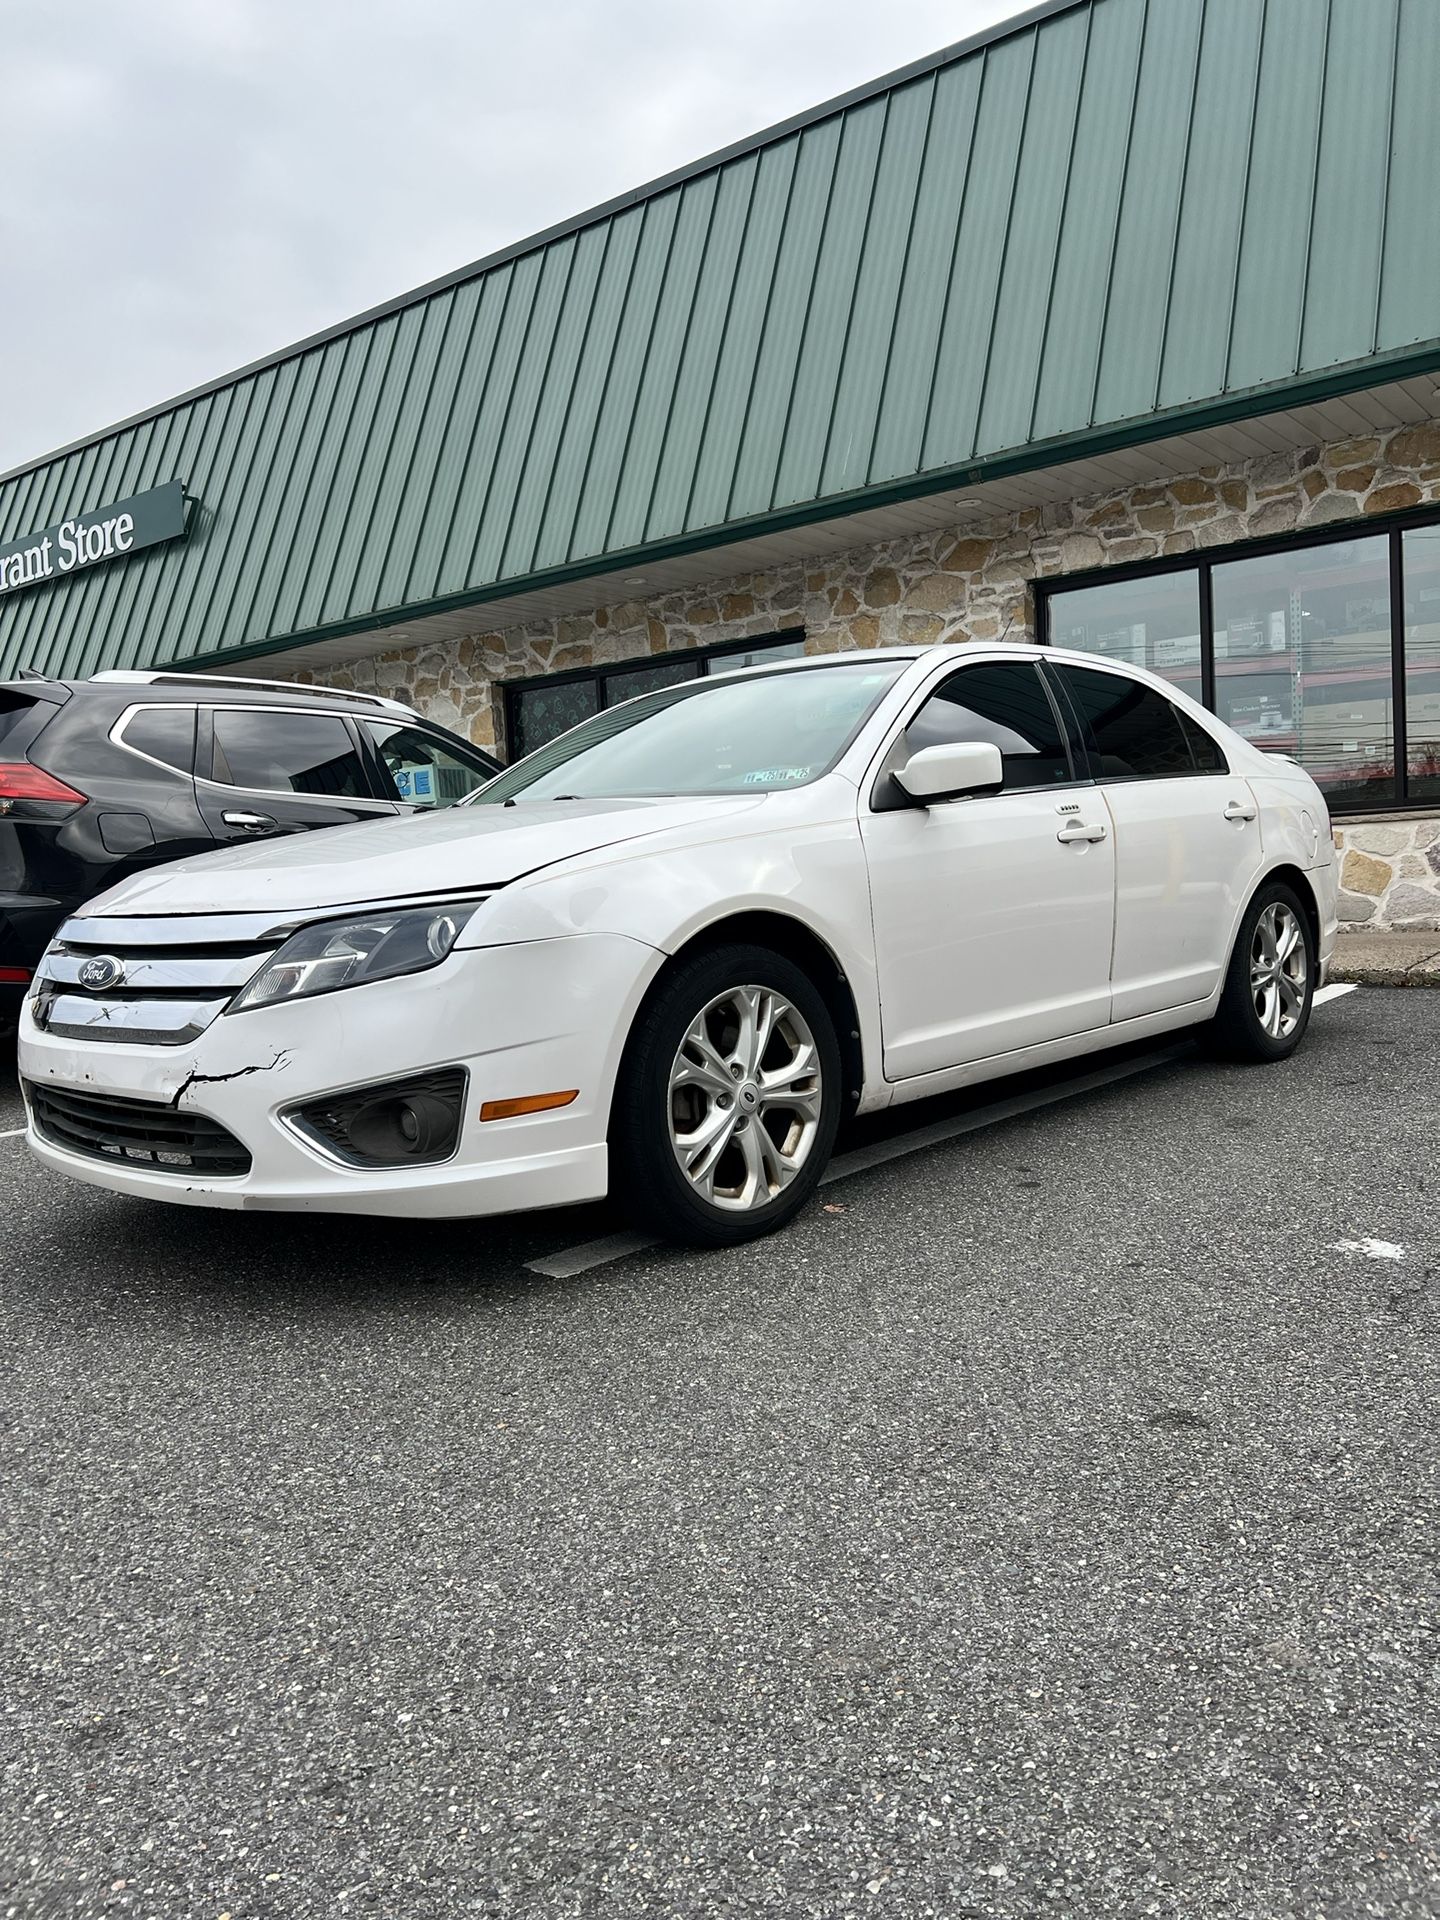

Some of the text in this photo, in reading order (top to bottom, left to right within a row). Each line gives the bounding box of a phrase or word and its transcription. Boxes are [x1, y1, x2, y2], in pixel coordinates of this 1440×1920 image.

[0, 513, 134, 591] rant Store
[82, 960, 108, 980] Ford
